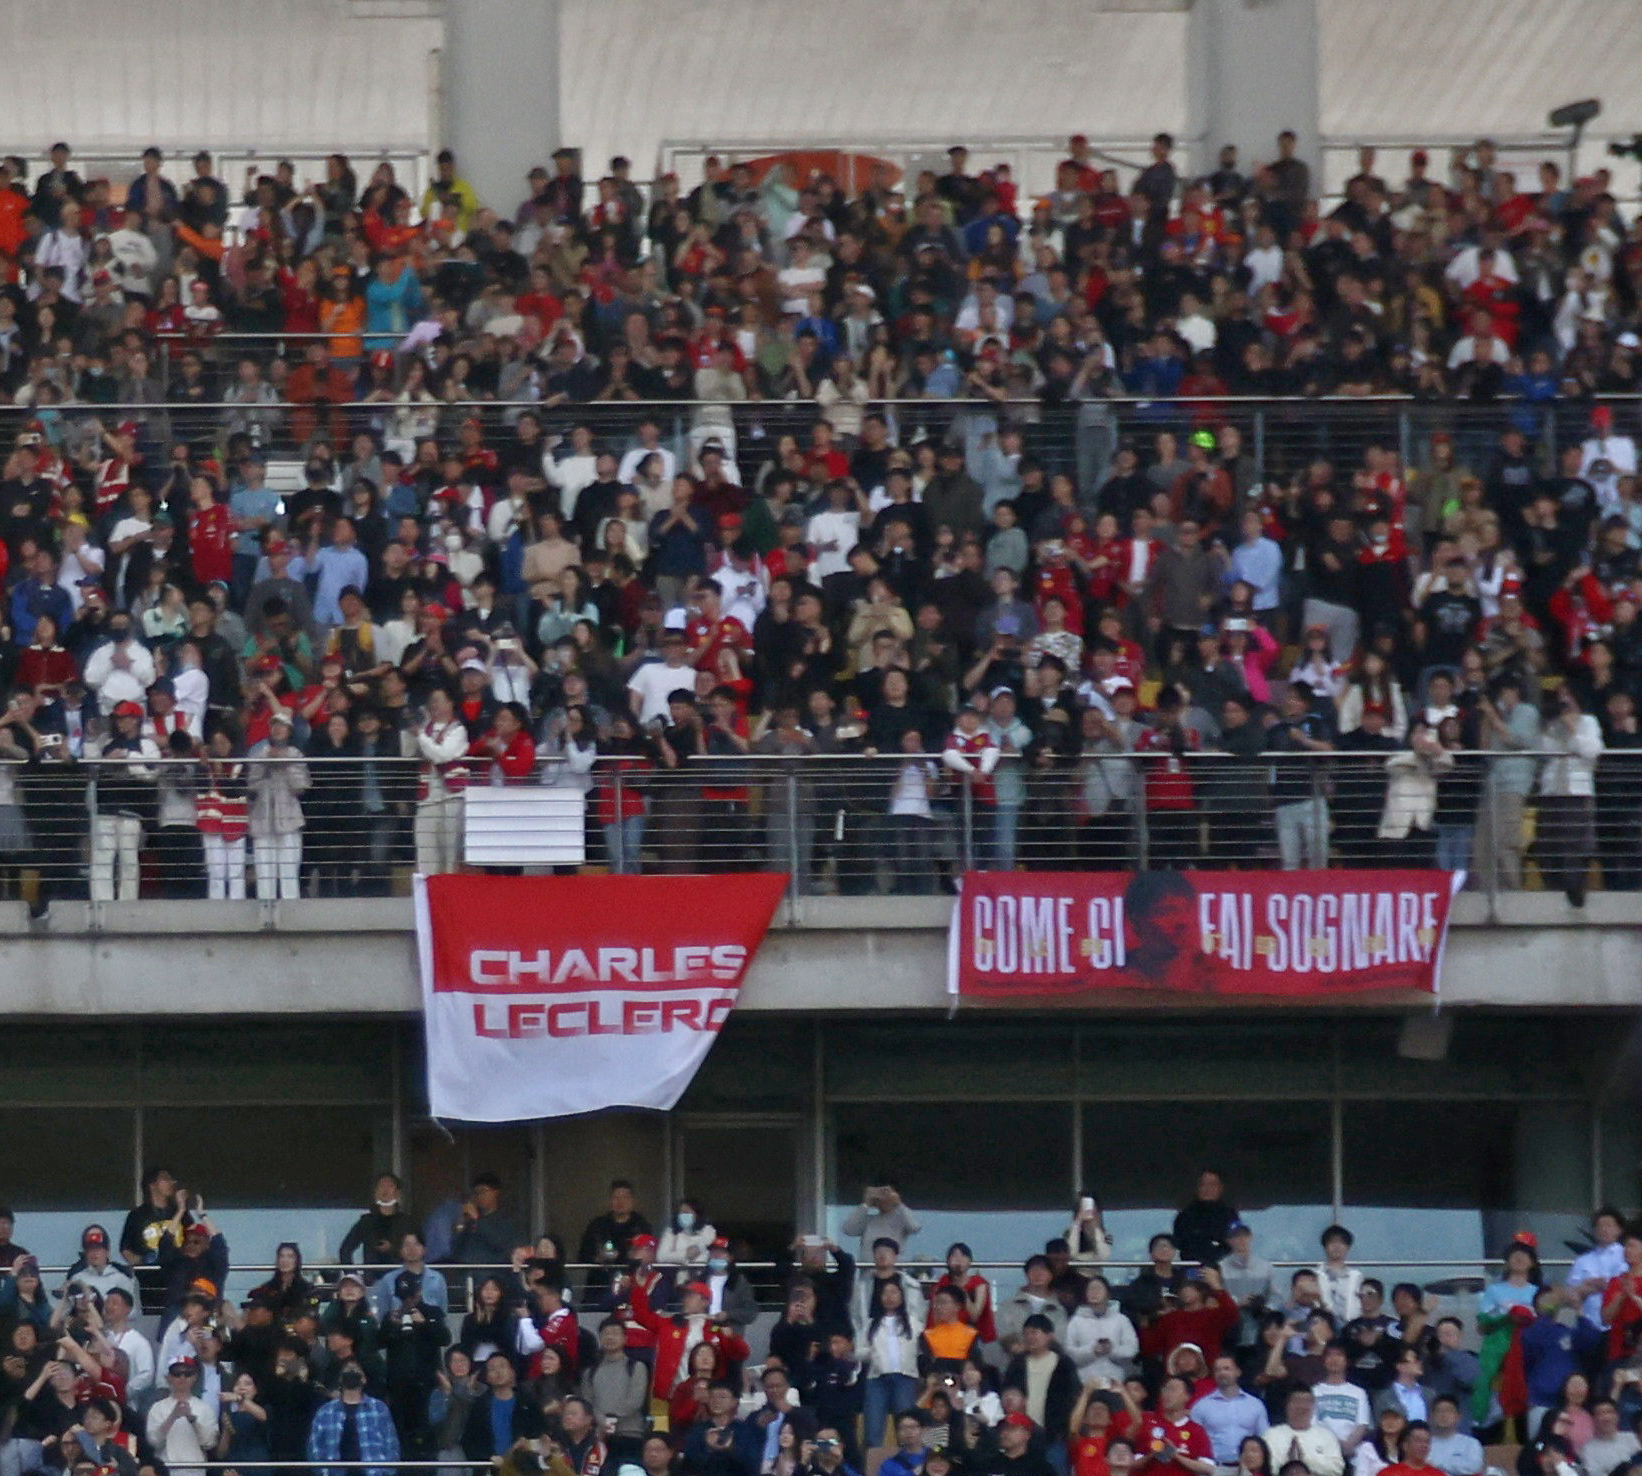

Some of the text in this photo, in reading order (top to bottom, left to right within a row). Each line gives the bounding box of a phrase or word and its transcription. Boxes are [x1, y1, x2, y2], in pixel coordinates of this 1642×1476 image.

[973, 892, 1439, 975] COME CI FAI SOGNARE
[469, 944, 748, 985] CHARLES
[473, 998, 736, 1040] LECLERC
